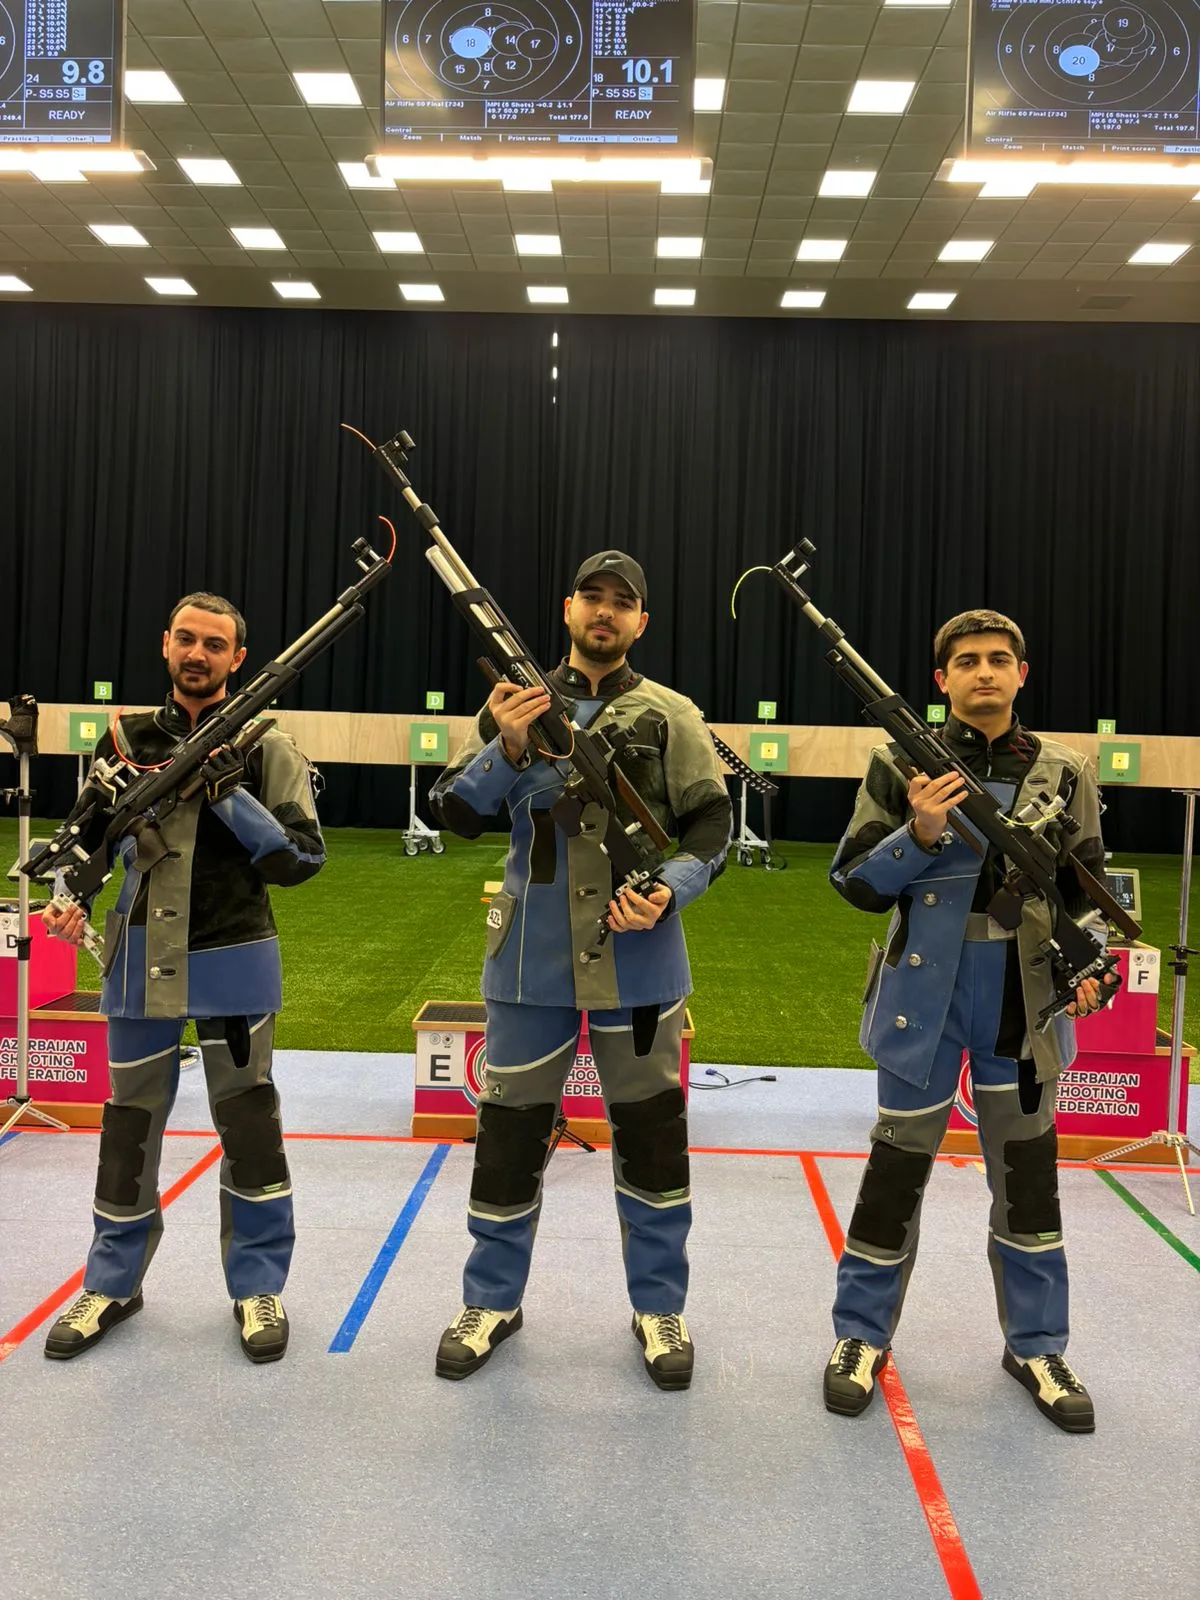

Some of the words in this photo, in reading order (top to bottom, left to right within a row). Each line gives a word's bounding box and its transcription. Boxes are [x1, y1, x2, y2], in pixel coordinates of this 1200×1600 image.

[484, 8, 492, 17] 8
[1118, 18, 1129, 28] 19
[402, 35, 410, 44] 6
[425, 35, 432, 43] 7
[466, 39, 476, 47] 18
[505, 36, 516, 45] 14
[530, 39, 541, 49] 17
[565, 35, 573, 44] 6
[1005, 44, 1012, 54] 6
[1029, 45, 1036, 54] 7
[1053, 45, 1060, 54] 8
[1150, 46, 1157, 55] 7
[1173, 47, 1180, 56] 6
[505, 61, 516, 70] 12
[1073, 56, 1086, 65] 20
[454, 64, 465, 74] 15
[483, 62, 490, 71] 8
[593, 73, 604, 82] 18
[622, 59, 672, 83] 10.1
[26, 74, 40, 83] 24
[62, 60, 105, 84] 9.8
[1088, 73, 1095, 82] 8
[483, 80, 490, 89] 7
[26, 89, 37, 98] P-
[39, 89, 53, 98] S5
[55, 89, 70, 98] S5
[592, 89, 603, 98] P-
[606, 89, 620, 98] S5
[622, 89, 636, 98] S5
[1088, 91, 1094, 100] 7
[48, 110, 86, 120] READY
[615, 110, 652, 120] READY
[99, 686, 107, 696] B
[431, 696, 440, 706] D
[764, 705, 771, 715] F
[931, 708, 941, 719] G
[1102, 723, 1112, 733] H
[1137, 970, 1149, 985] F
[1, 1039, 86, 1053] AZRBAIJAN
[1, 1053, 74, 1066] SHOTING
[430, 1054, 451, 1082] E
[1, 1068, 86, 1081] FEERATION
[1058, 1072, 1138, 1086] ZERBAIJAN
